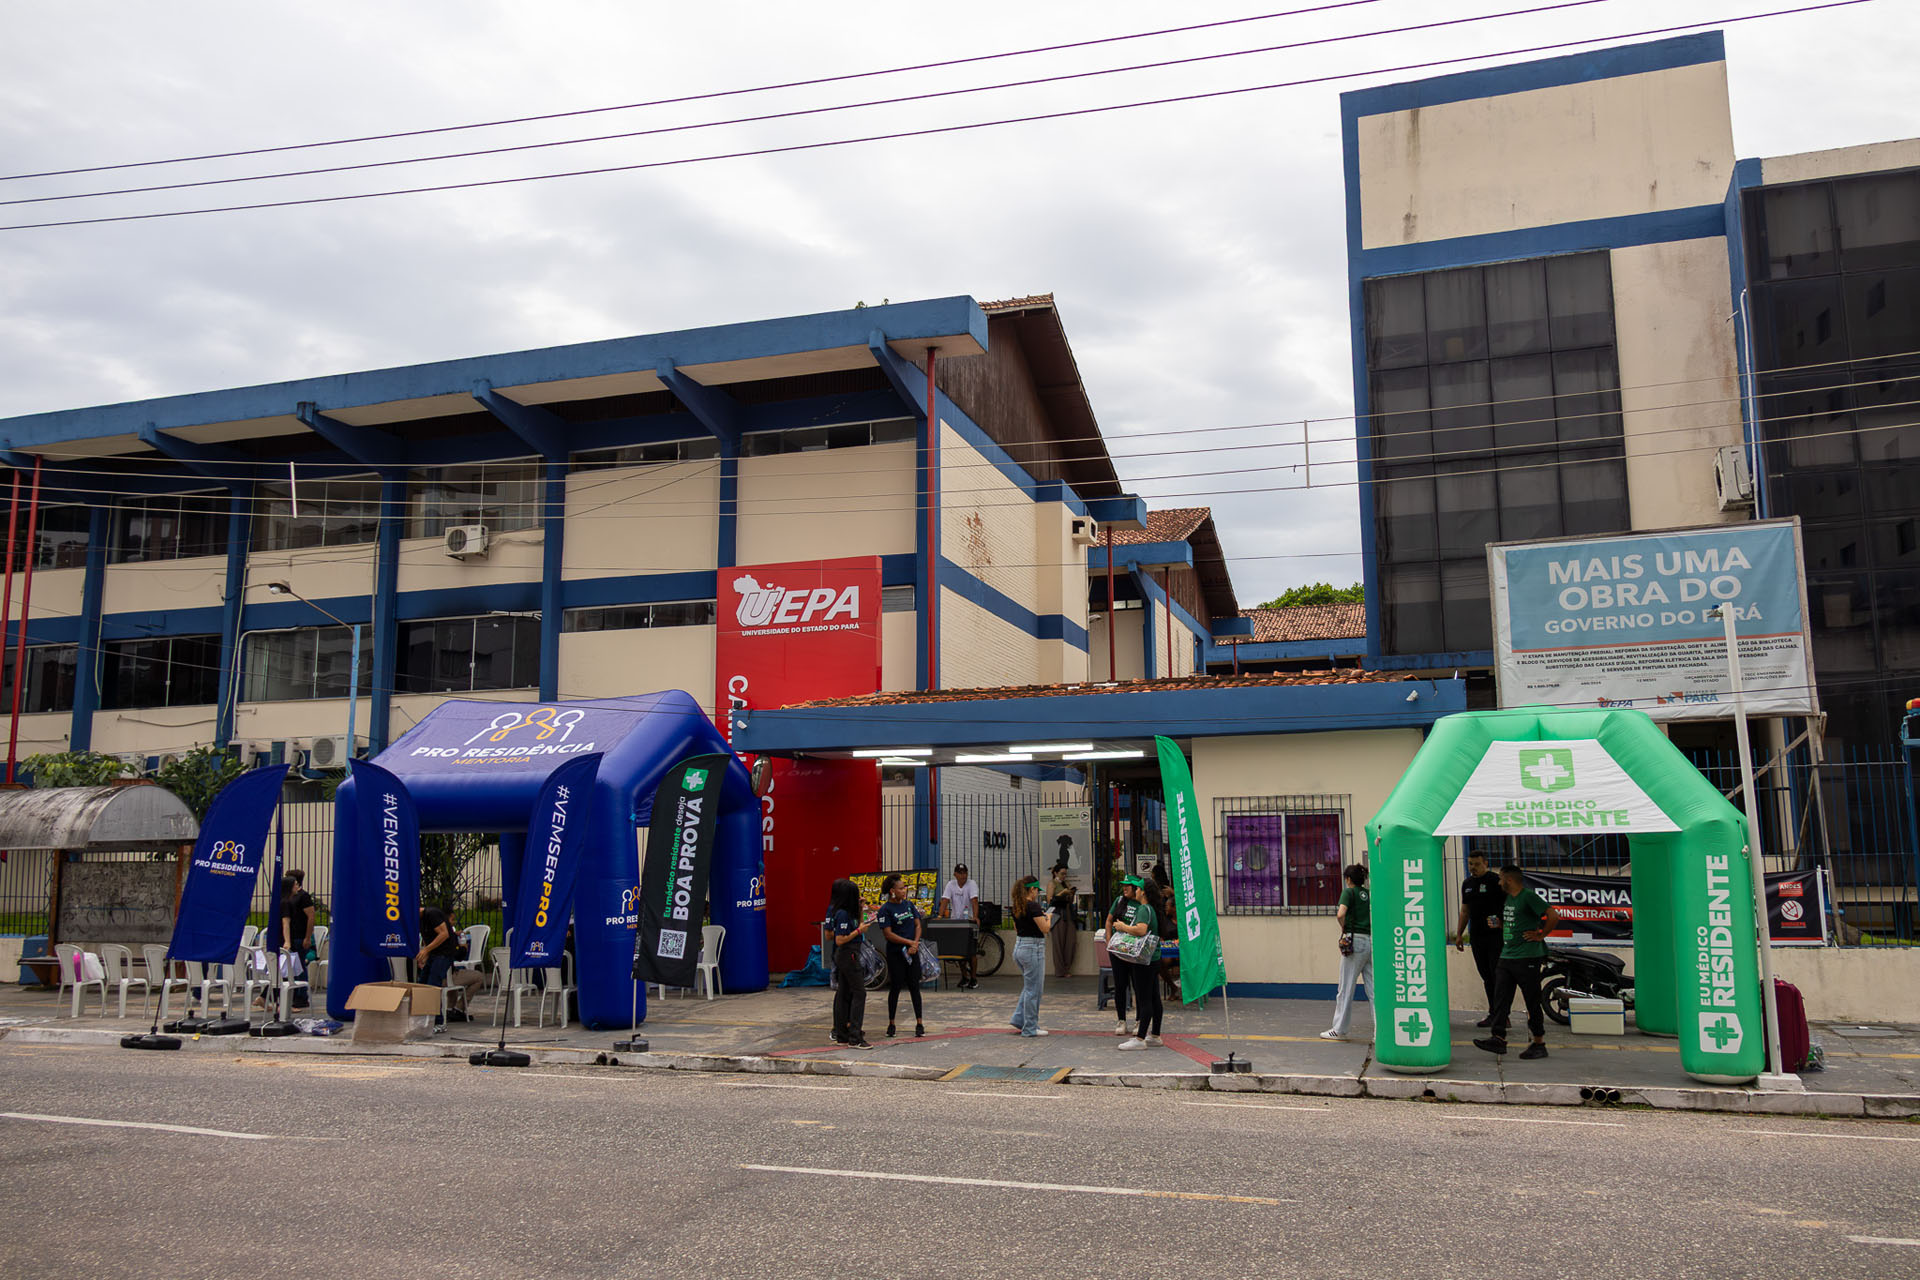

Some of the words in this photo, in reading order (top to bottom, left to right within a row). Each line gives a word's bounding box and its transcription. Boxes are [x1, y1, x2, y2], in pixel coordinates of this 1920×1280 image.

[1548, 554, 1644, 585] MAIS
[1655, 546, 1752, 576] UMA
[740, 586, 860, 626] UEPA
[1558, 580, 1670, 612] OBRA
[1680, 575, 1742, 602] DO
[742, 628, 790, 636] UNIVERSIDADE
[840, 622, 860, 630] PARÁ
[1544, 612, 1654, 634] GOVERNO
[1660, 610, 1696, 626] DO
[1702, 602, 1762, 623] PRÁ
[1600, 698, 1633, 708] UEPA
[410, 746, 460, 758] PRO
[462, 742, 595, 758] RESIDÊNCIA
[452, 756, 531, 765] MENTORIA
[675, 796, 686, 826] deseja
[1477, 810, 1630, 828] RESIDENTE
[1506, 801, 1526, 810] EU
[1531, 798, 1597, 810] MÉDICO
[670, 827, 682, 870] residente
[679, 797, 703, 871] PROVA
[1176, 791, 1196, 906] RESIDENTE
[194, 859, 210, 868] PRO
[211, 862, 254, 873] RESIDÊNCIA
[383, 792, 400, 921] #VEMSERPRO
[535, 784, 570, 928] #VEMSERPRO
[666, 872, 675, 905] médico
[672, 875, 693, 921] BOA
[1534, 888, 1632, 905] REFORMA
[606, 916, 624, 925] PRO
[664, 906, 671, 918] Eu
[1403, 859, 1428, 1003] RESIDENTE
[1706, 855, 1736, 1007] RESIDENTE
[1392, 927, 1404, 981] MÉDICO
[1696, 926, 1710, 984] MÉDICO
[1396, 985, 1405, 1002] EU
[1700, 987, 1711, 1006] EU
